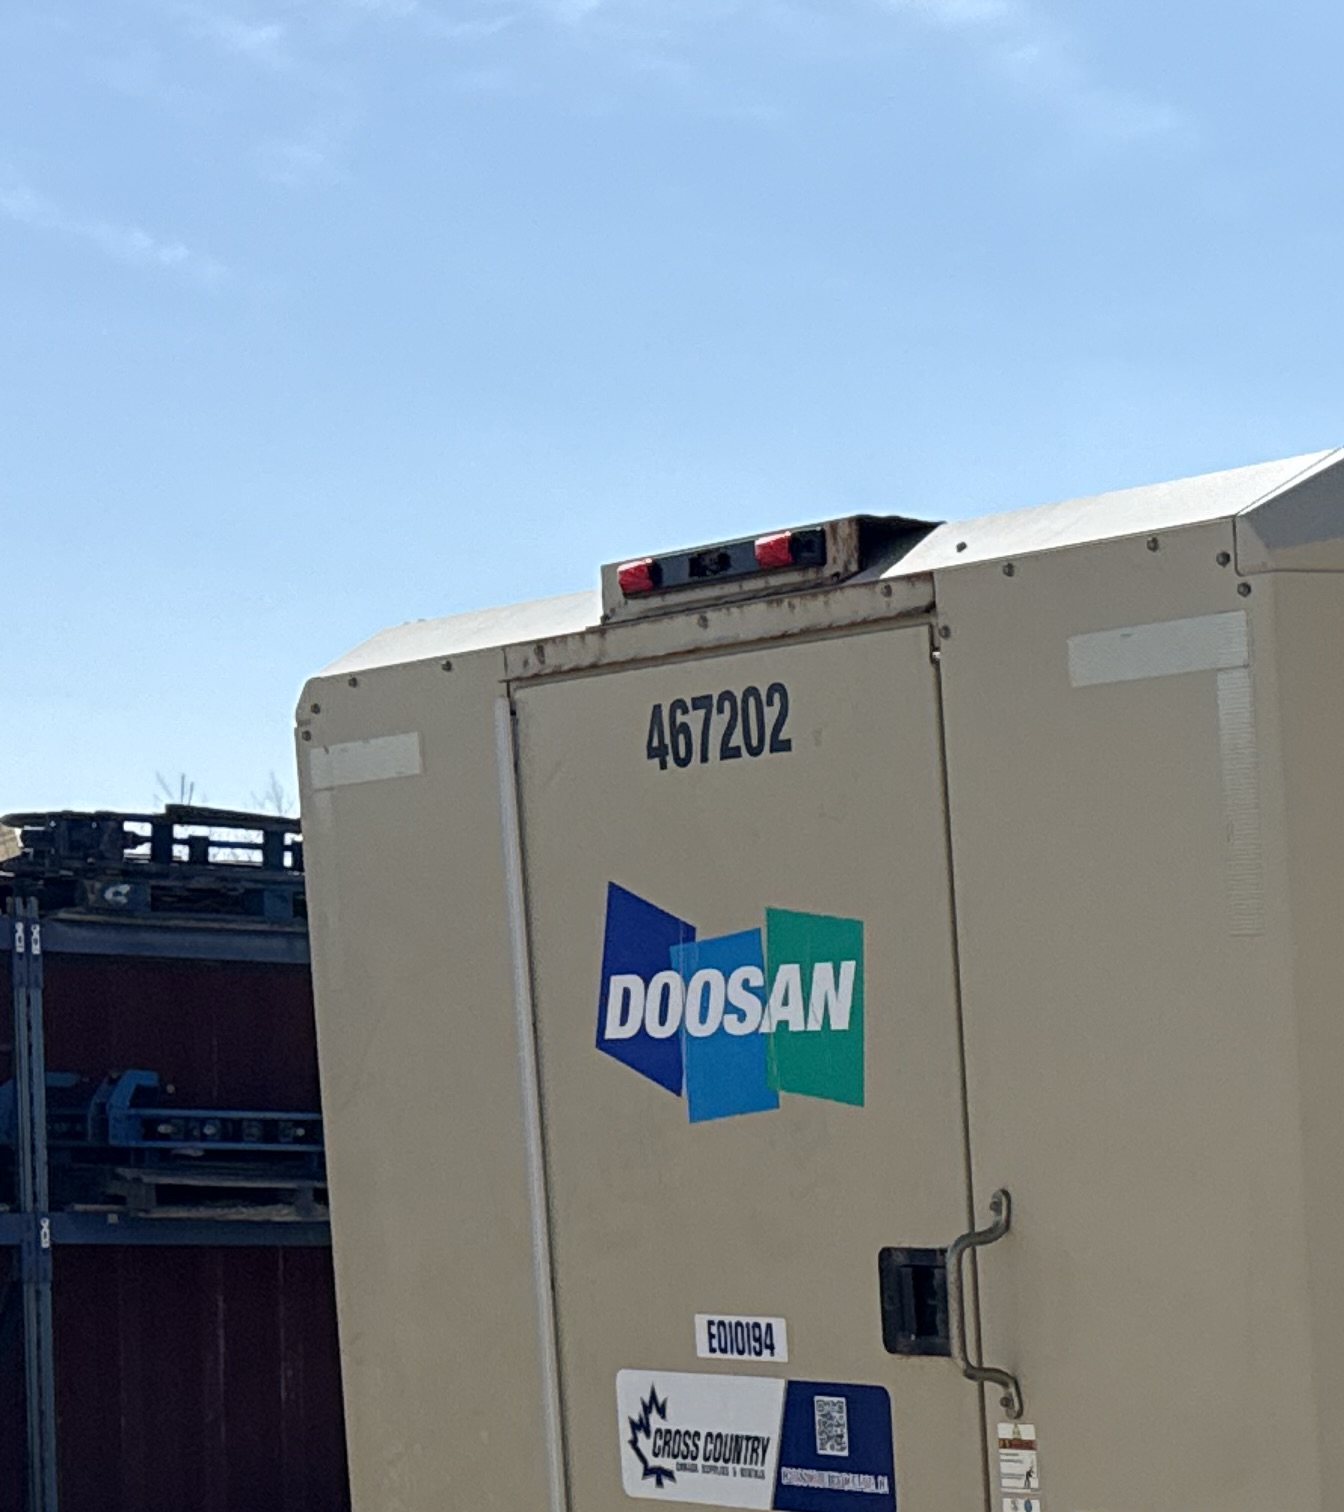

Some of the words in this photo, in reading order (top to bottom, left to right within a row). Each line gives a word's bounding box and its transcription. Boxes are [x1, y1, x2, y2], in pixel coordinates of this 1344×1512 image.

[646, 682, 792, 770] 467202
[604, 960, 856, 1040] DOOSAN
[651, 1427, 700, 1461] CROSS
[702, 1431, 771, 1467] COUNTRY
